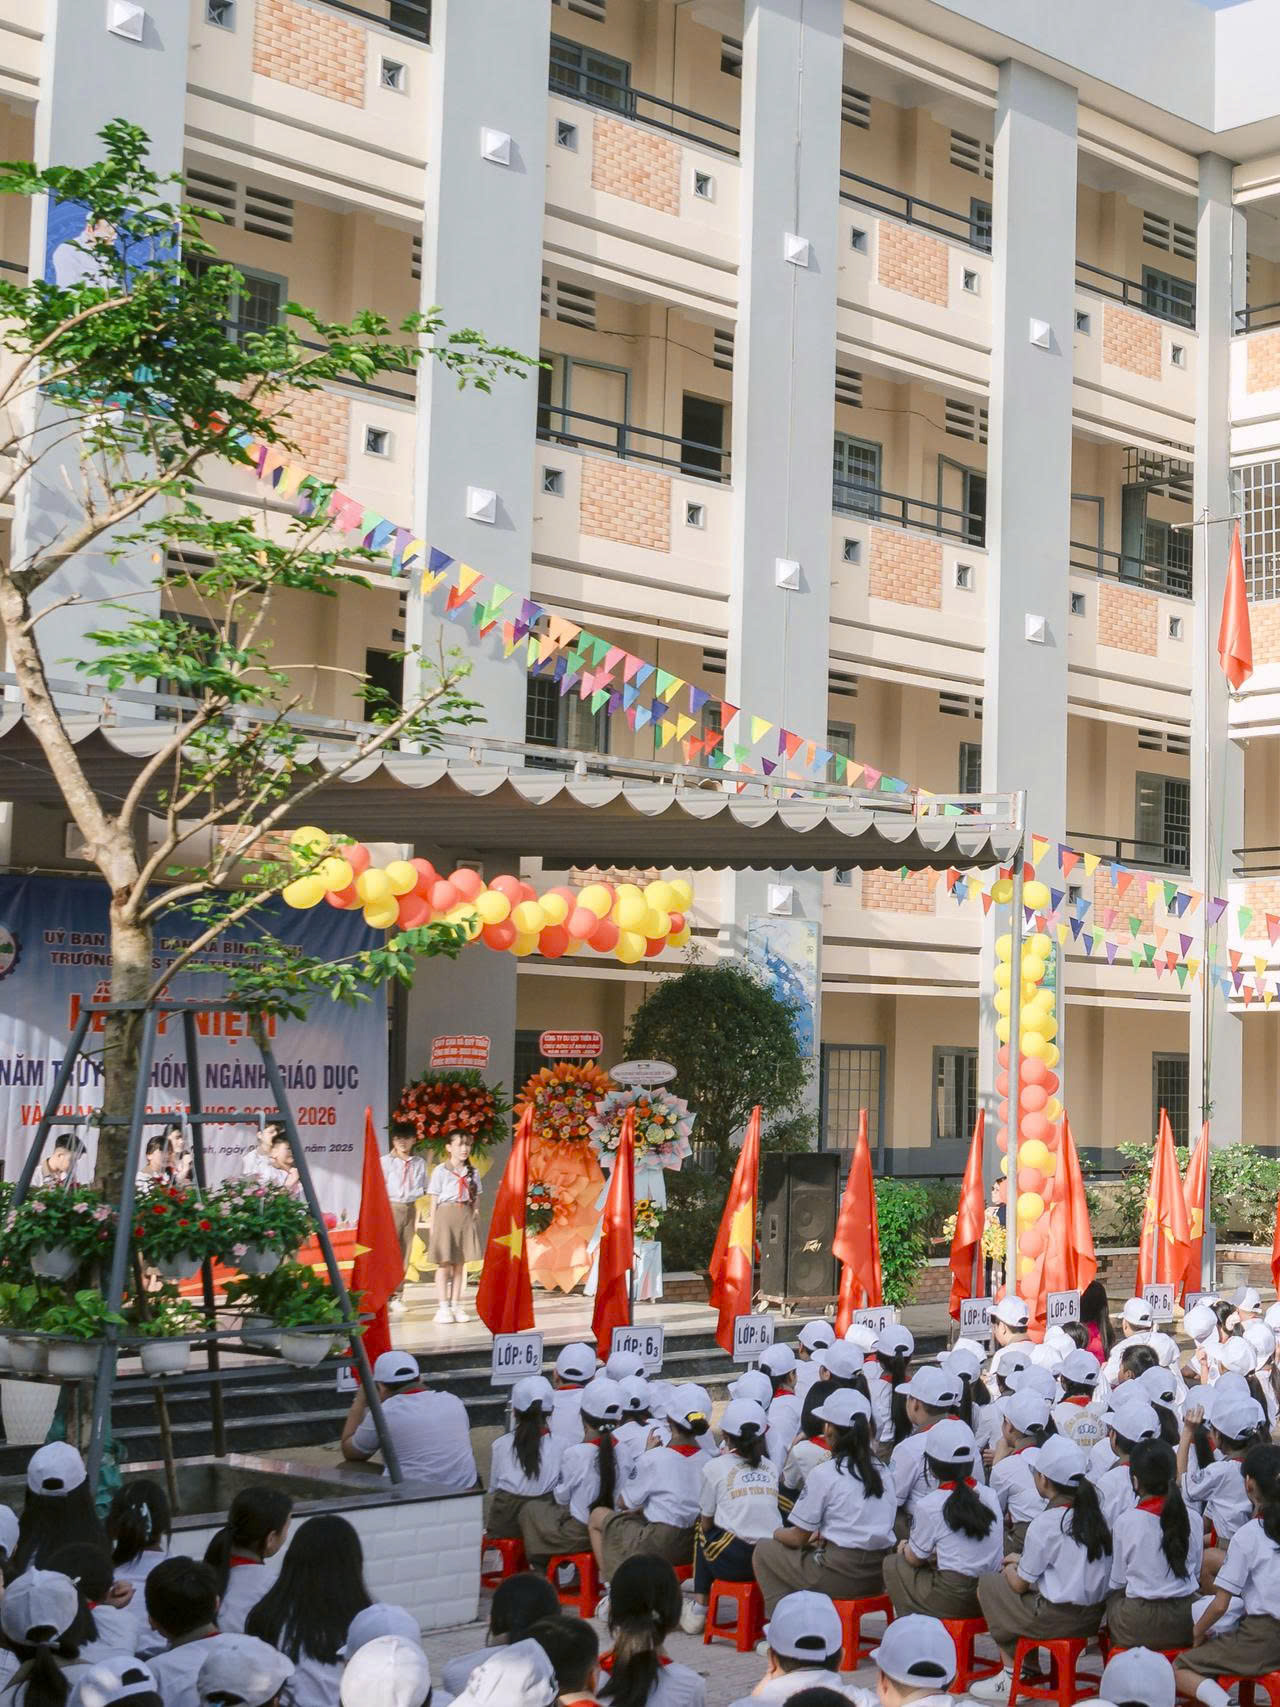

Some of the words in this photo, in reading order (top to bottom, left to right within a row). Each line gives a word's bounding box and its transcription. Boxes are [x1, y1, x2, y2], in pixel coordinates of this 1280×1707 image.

[70, 932, 105, 946] BAN
[206, 1059, 270, 1089] NGÀNH
[323, 1064, 360, 1095] DỤC
[297, 1106, 336, 1126] 2026
[305, 1145, 326, 1153] năm
[330, 1143, 354, 1153] 2025
[964, 1306, 980, 1325] LỚP:
[1050, 1299, 1067, 1318] LỚP:
[738, 1323, 758, 1344] LỚP:
[498, 1342, 523, 1366] LỚP:
